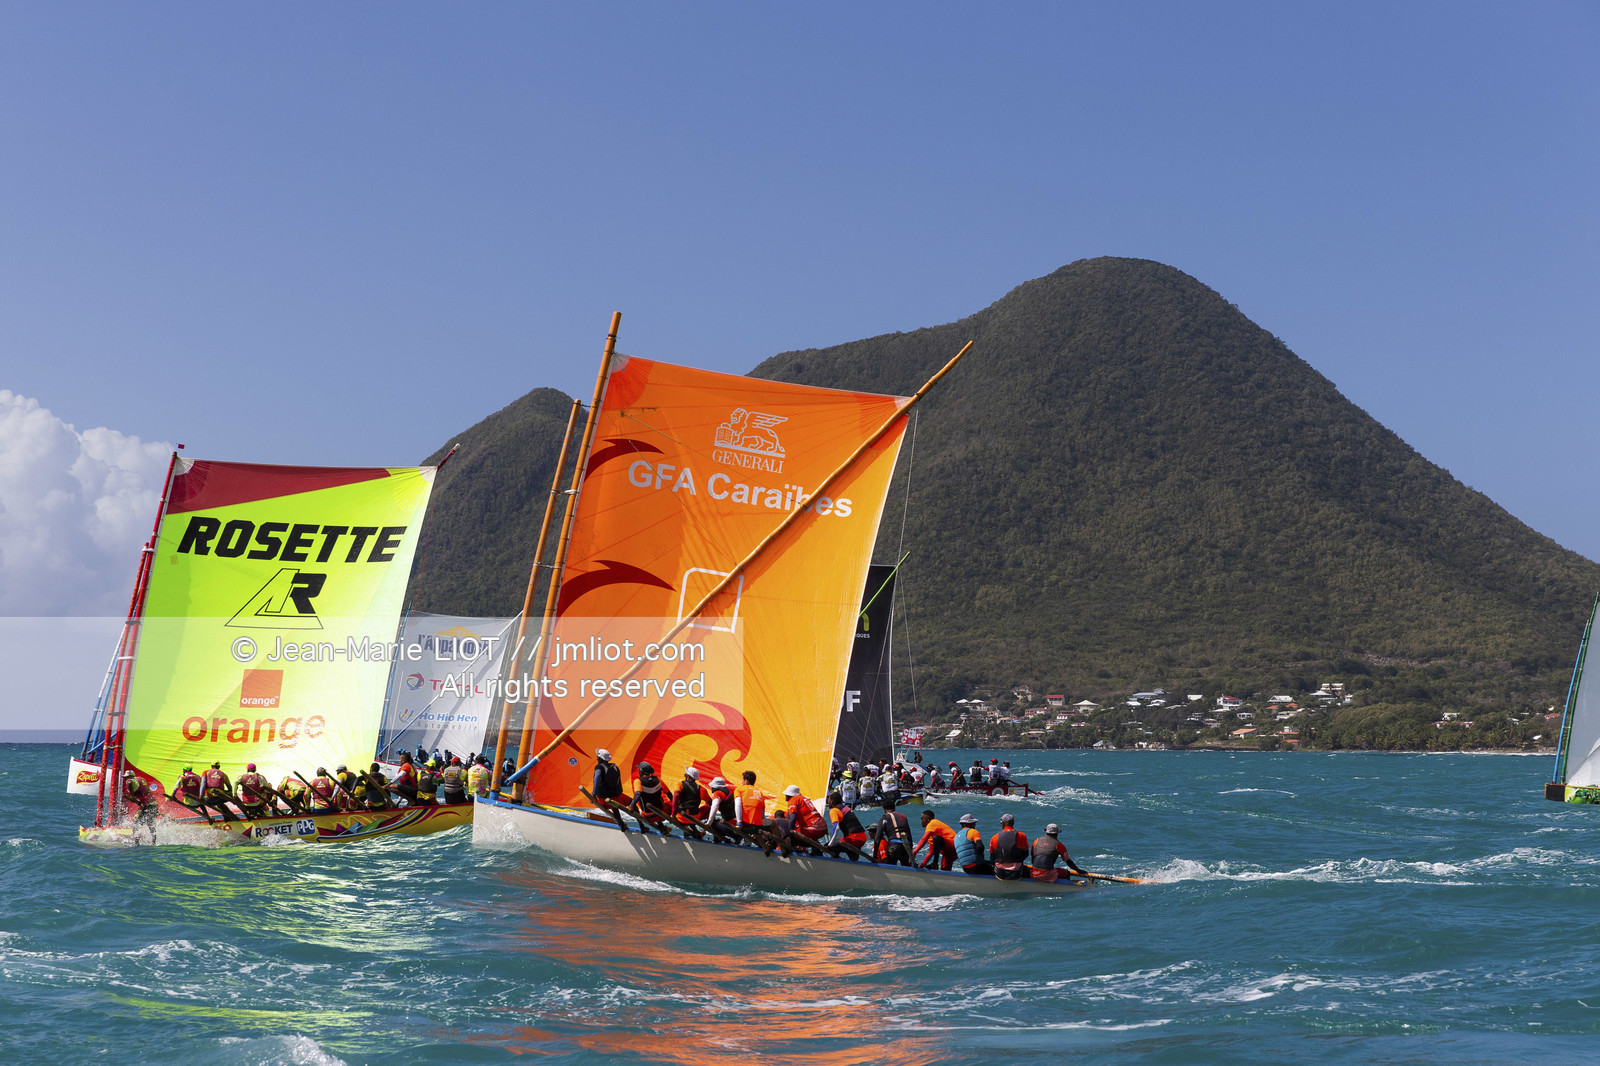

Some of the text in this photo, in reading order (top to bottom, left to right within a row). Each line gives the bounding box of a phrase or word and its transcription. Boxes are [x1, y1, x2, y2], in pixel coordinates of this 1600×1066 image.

[712, 449, 785, 474] GENERALI
[627, 459, 853, 518] GFA Caraïbes
[176, 516, 408, 563] ROSETTE
[182, 714, 326, 749] orange
[436, 713, 456, 722] Hio
[456, 714, 478, 723] Hen
